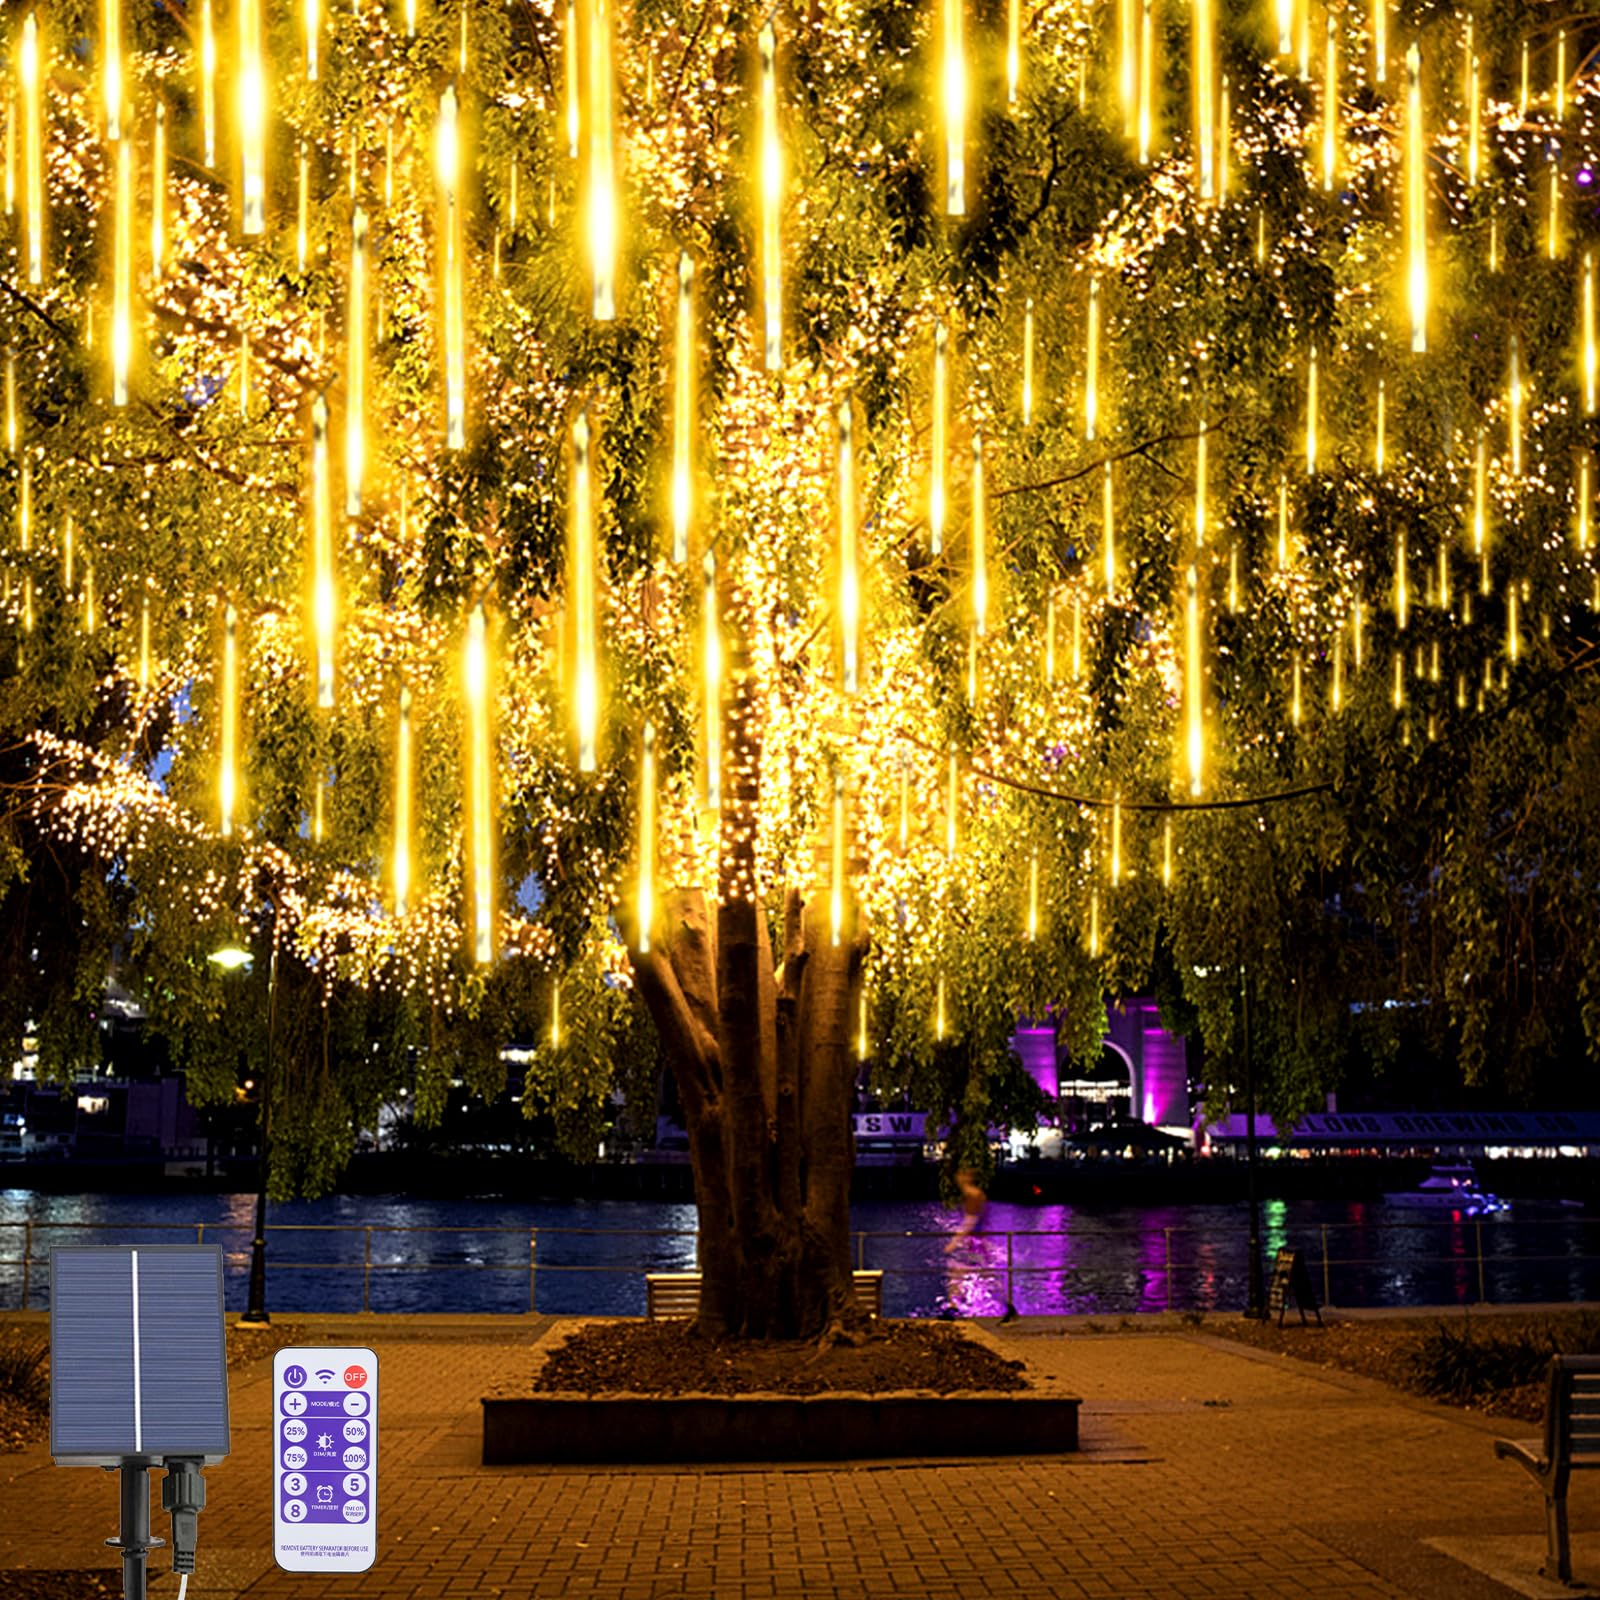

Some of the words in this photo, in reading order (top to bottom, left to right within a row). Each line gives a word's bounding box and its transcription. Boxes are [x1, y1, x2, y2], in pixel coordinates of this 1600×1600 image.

[1391, 1115, 1526, 1133] BREWING
[344, 1372, 366, 1382] OFF
[286, 1426, 305, 1436] 25%
[345, 1427, 365, 1436] 50%
[286, 1453, 305, 1462] 75%
[344, 1454, 366, 1463] 100%
[290, 1478, 300, 1491] 3
[350, 1478, 360, 1492] 5
[290, 1504, 300, 1518] 8
